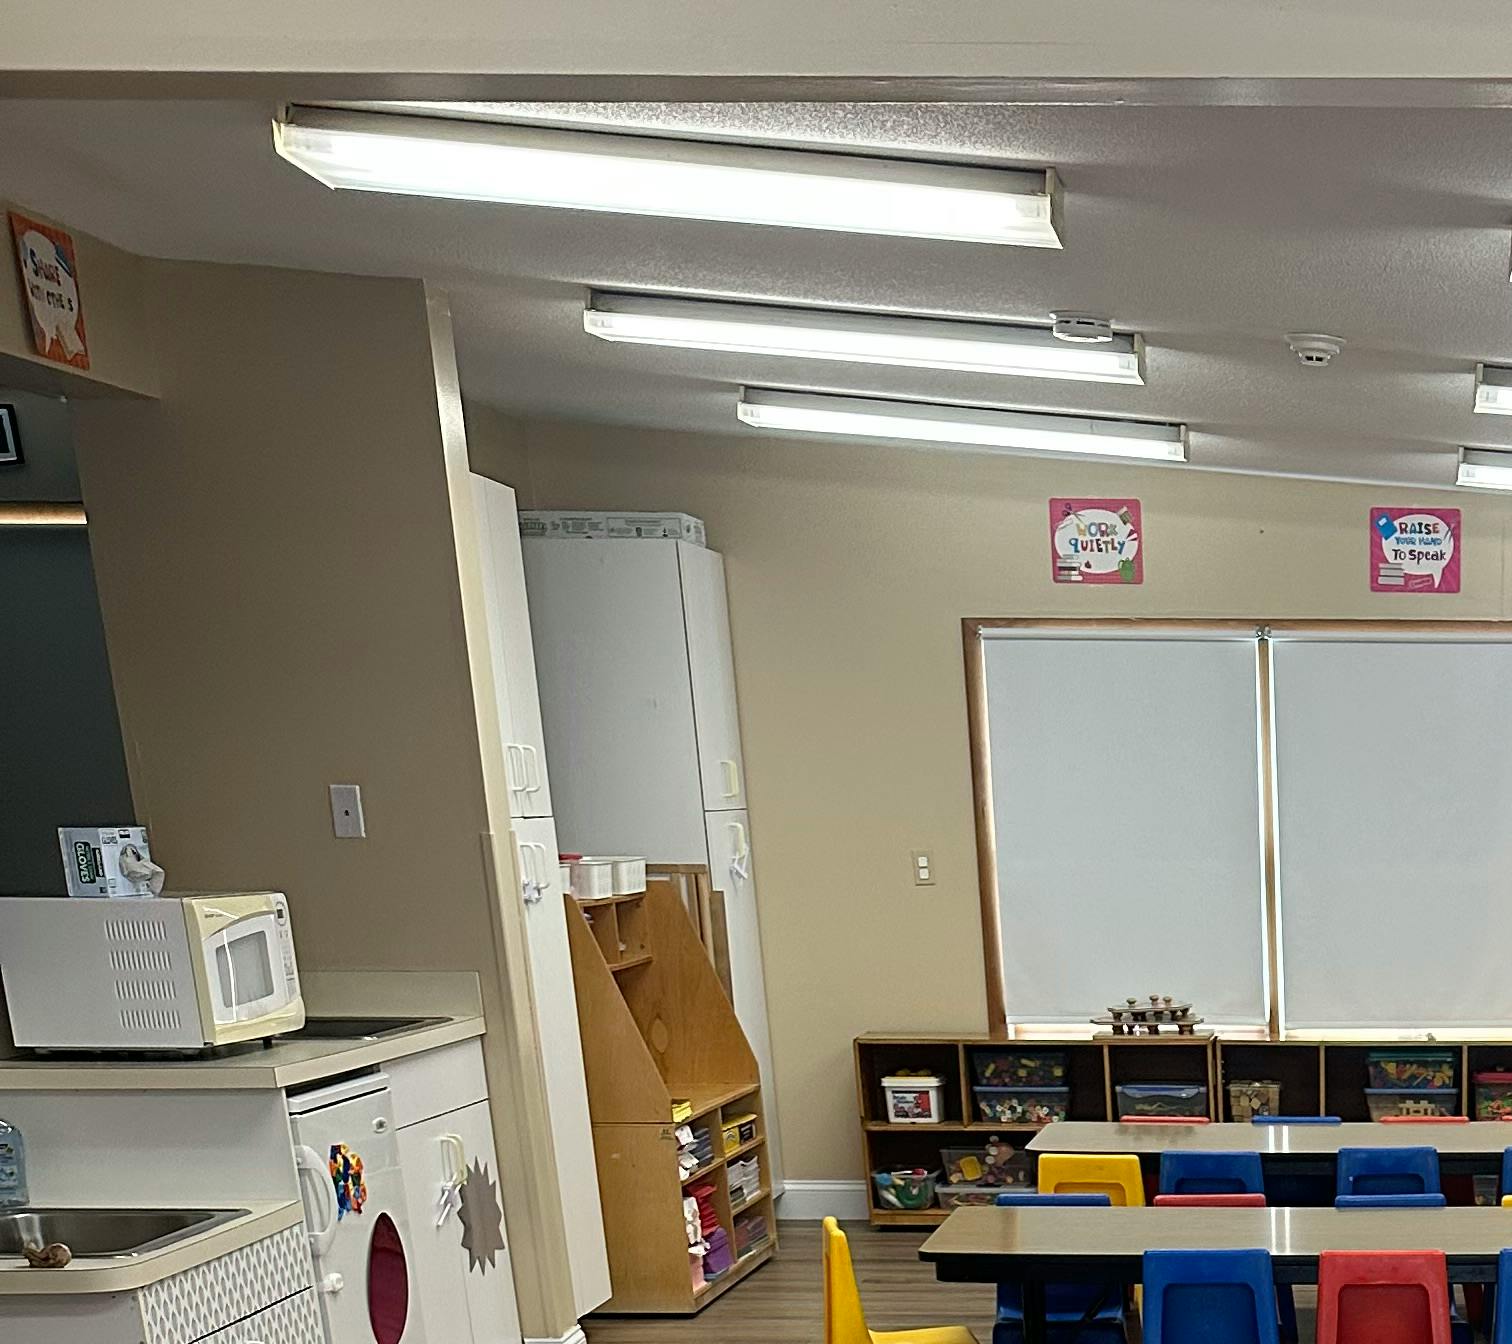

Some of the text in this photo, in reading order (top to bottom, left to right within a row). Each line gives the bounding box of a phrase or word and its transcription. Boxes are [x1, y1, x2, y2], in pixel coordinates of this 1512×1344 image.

[46, 291, 73, 312] OTHES
[1076, 522, 1118, 537] WORK
[1399, 522, 1440, 535] RAISE
[1392, 549, 1446, 565] To Speak
[75, 843, 90, 883] GLOVES
